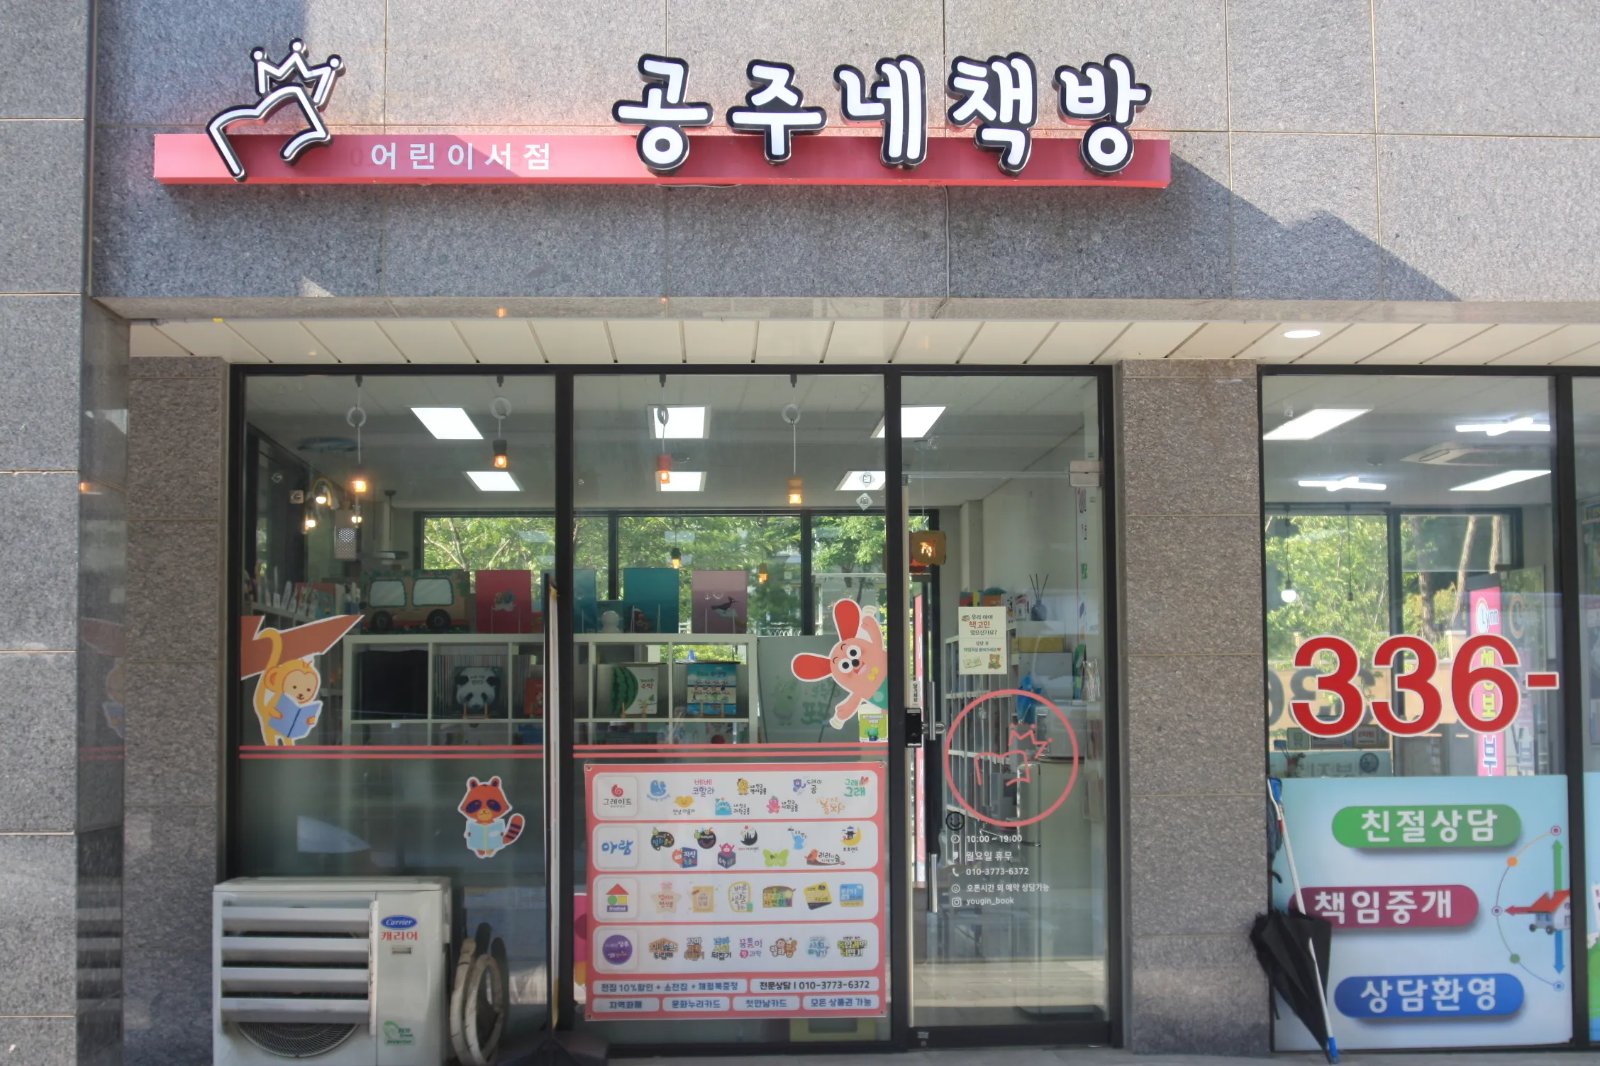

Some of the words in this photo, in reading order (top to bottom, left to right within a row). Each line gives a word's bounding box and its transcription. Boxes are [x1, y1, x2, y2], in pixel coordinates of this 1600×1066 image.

[370, 142, 550, 171] 어린이서점
[1290, 633, 1560, 738] 336-
[1360, 808, 1498, 844] 친절상담
[967, 835, 990, 843] 10:00
[1000, 834, 1023, 843] 19:00
[965, 851, 993, 861] 월요일
[994, 851, 1013, 861] 휴무
[965, 867, 1029, 876] 010-3773-6372
[1314, 889, 1452, 925] 책임중개
[385, 918, 413, 927] Carrier
[381, 931, 419, 941] 캐리어
[760, 981, 791, 990] 전문상담
[798, 980, 870, 990] 010-3773-6372
[1360, 976, 1498, 1014] 상담환영
[671, 999, 721, 1009] 문화누리카드
[810, 998, 827, 1007] 모든
[856, 998, 872, 1007] 가능
